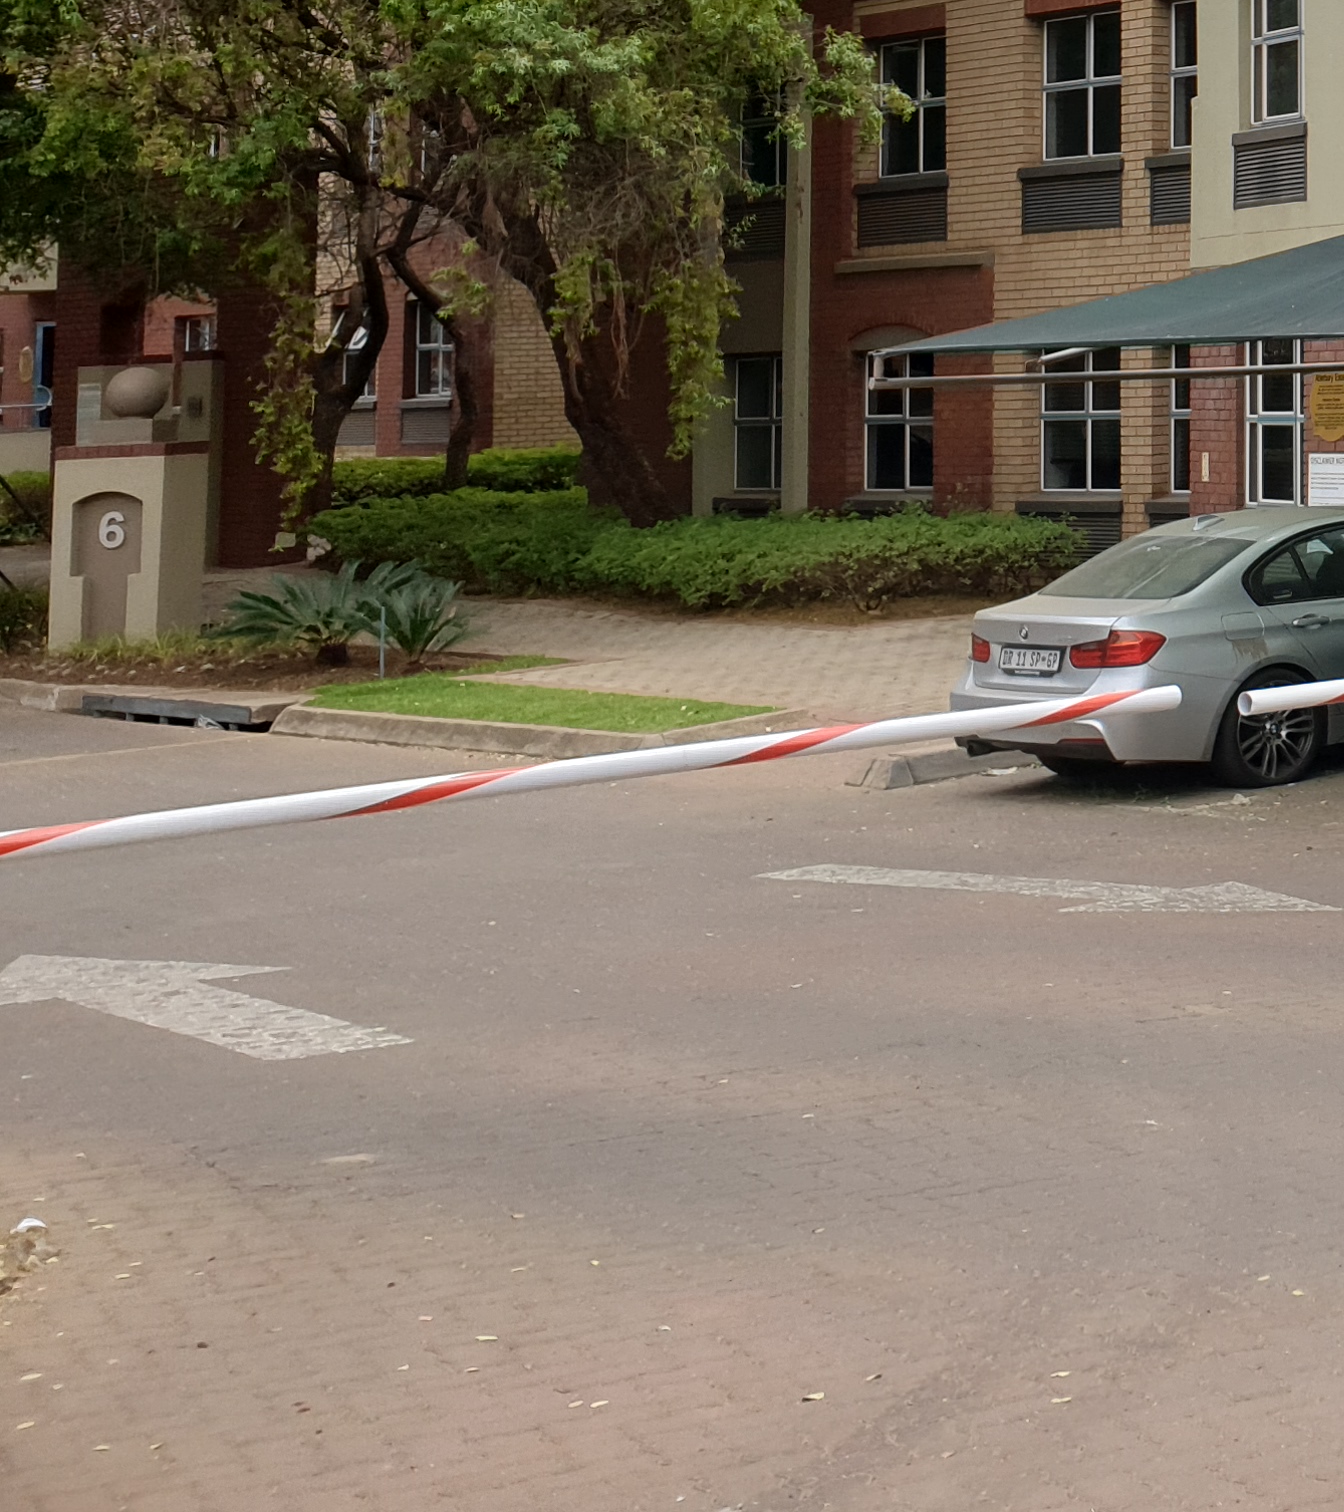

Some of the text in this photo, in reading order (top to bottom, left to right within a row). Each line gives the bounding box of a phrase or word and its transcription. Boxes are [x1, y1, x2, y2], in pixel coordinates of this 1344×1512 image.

[98, 510, 125, 549] 6
[1016, 651, 1026, 667] 11
[1030, 651, 1041, 667] SP
